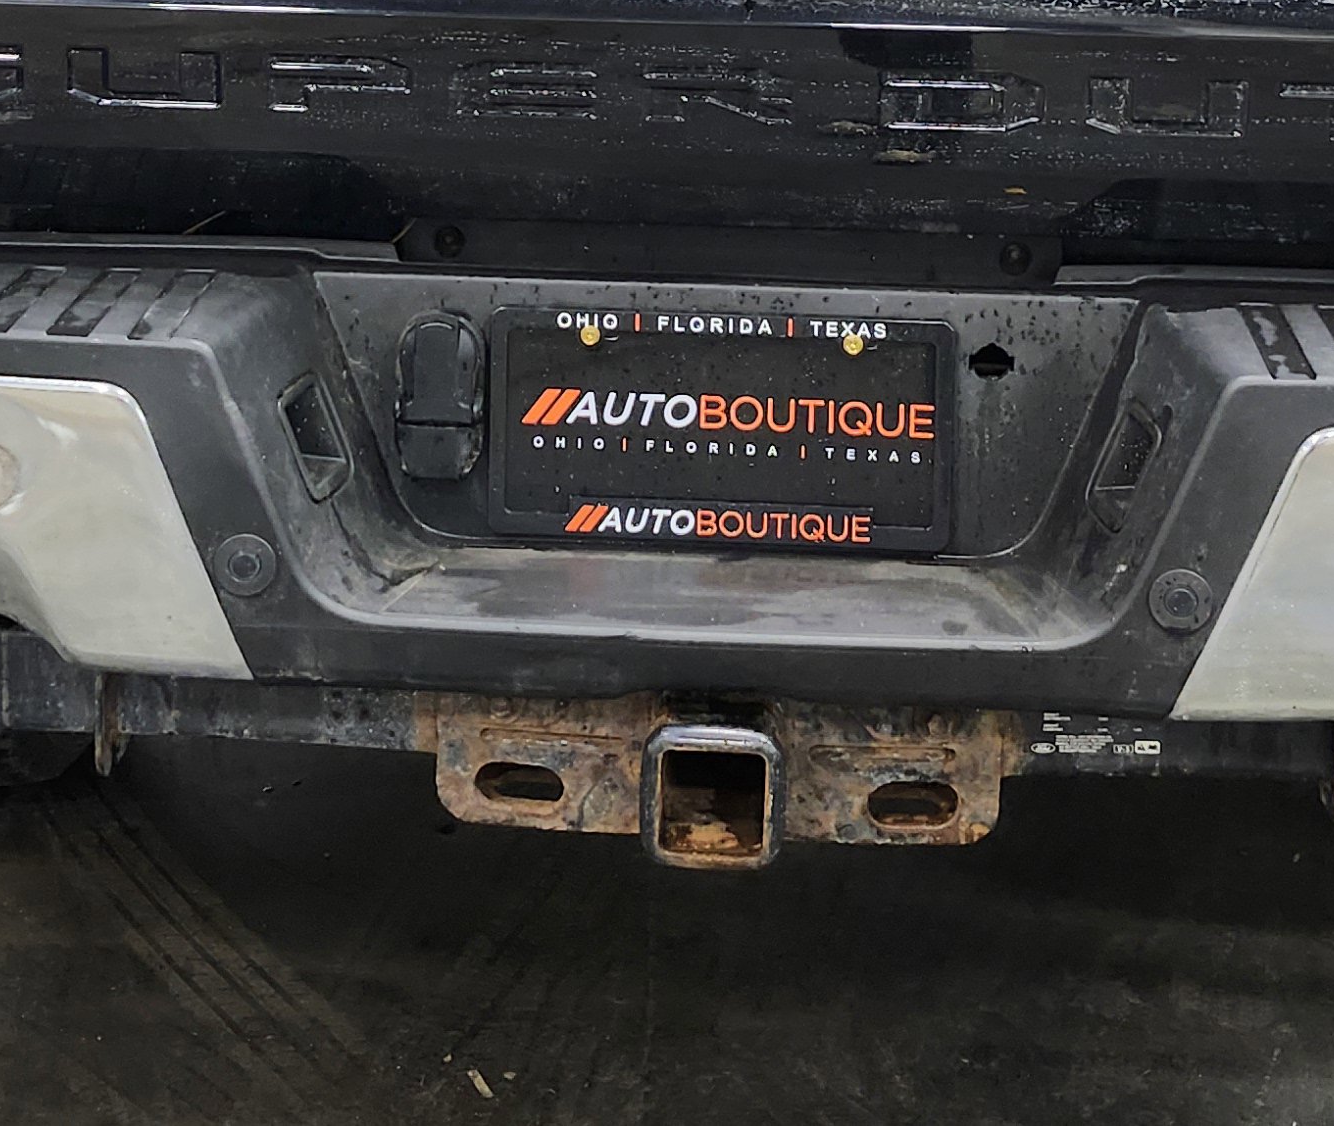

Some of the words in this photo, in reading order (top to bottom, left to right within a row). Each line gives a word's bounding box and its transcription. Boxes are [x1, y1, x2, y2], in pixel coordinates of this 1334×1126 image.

[556, 311, 618, 330] OHIO
[657, 315, 773, 336] FLORIDA
[809, 319, 887, 340] TEXAS
[566, 391, 937, 440] AUTOBOUTIQUE
[533, 435, 606, 452] OHIO
[646, 439, 779, 458] FLORIDA
[824, 446, 921, 465] TEXAS
[599, 506, 872, 544] AUTOBOUTIQUE
